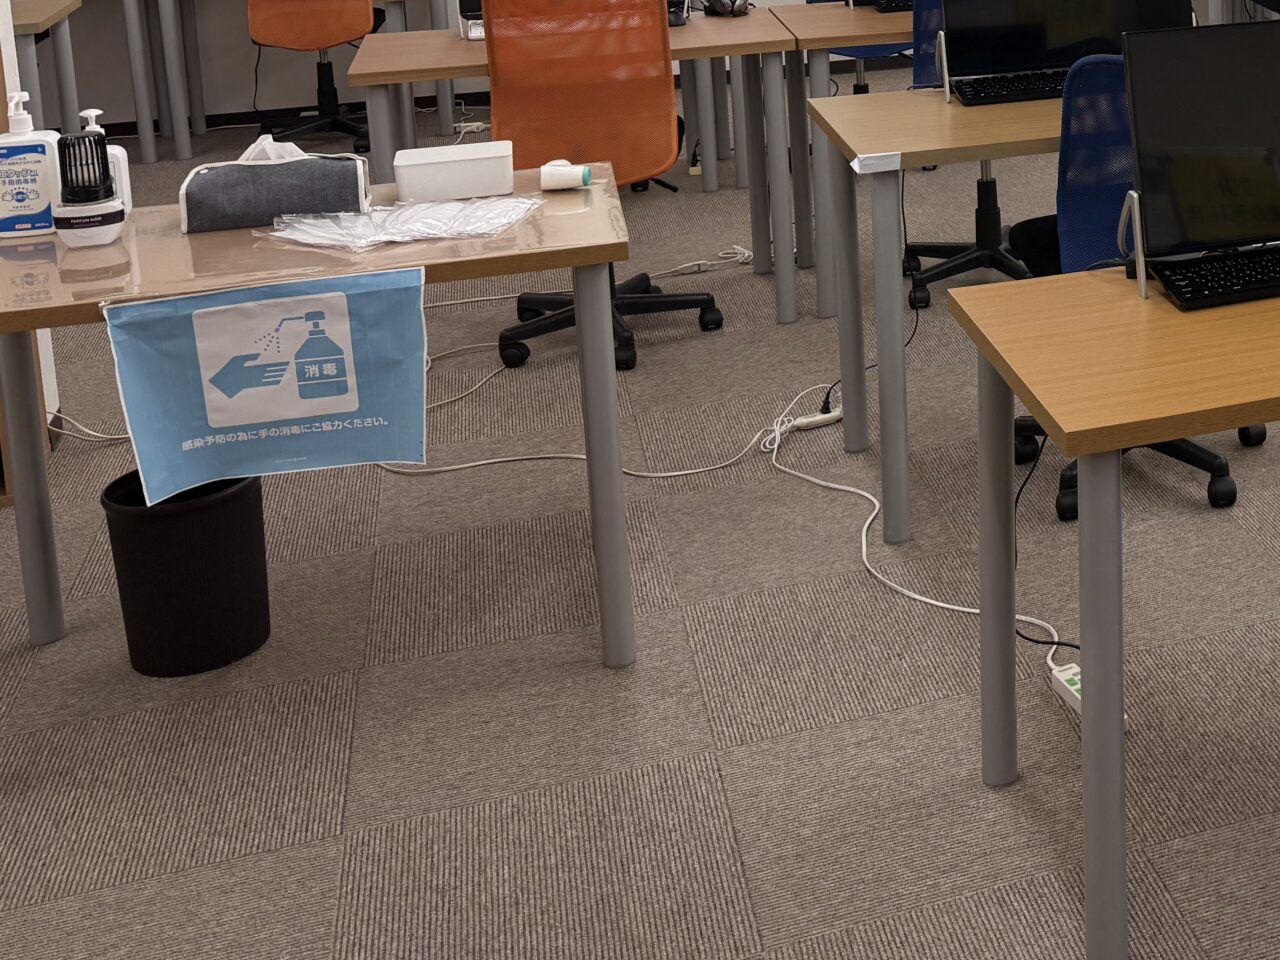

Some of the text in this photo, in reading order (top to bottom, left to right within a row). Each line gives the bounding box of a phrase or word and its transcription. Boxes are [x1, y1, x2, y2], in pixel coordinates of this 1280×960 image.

[304, 363, 338, 378] 消毒
[182, 416, 389, 451] 感染予防の為に手の消毒にご協力ください。
